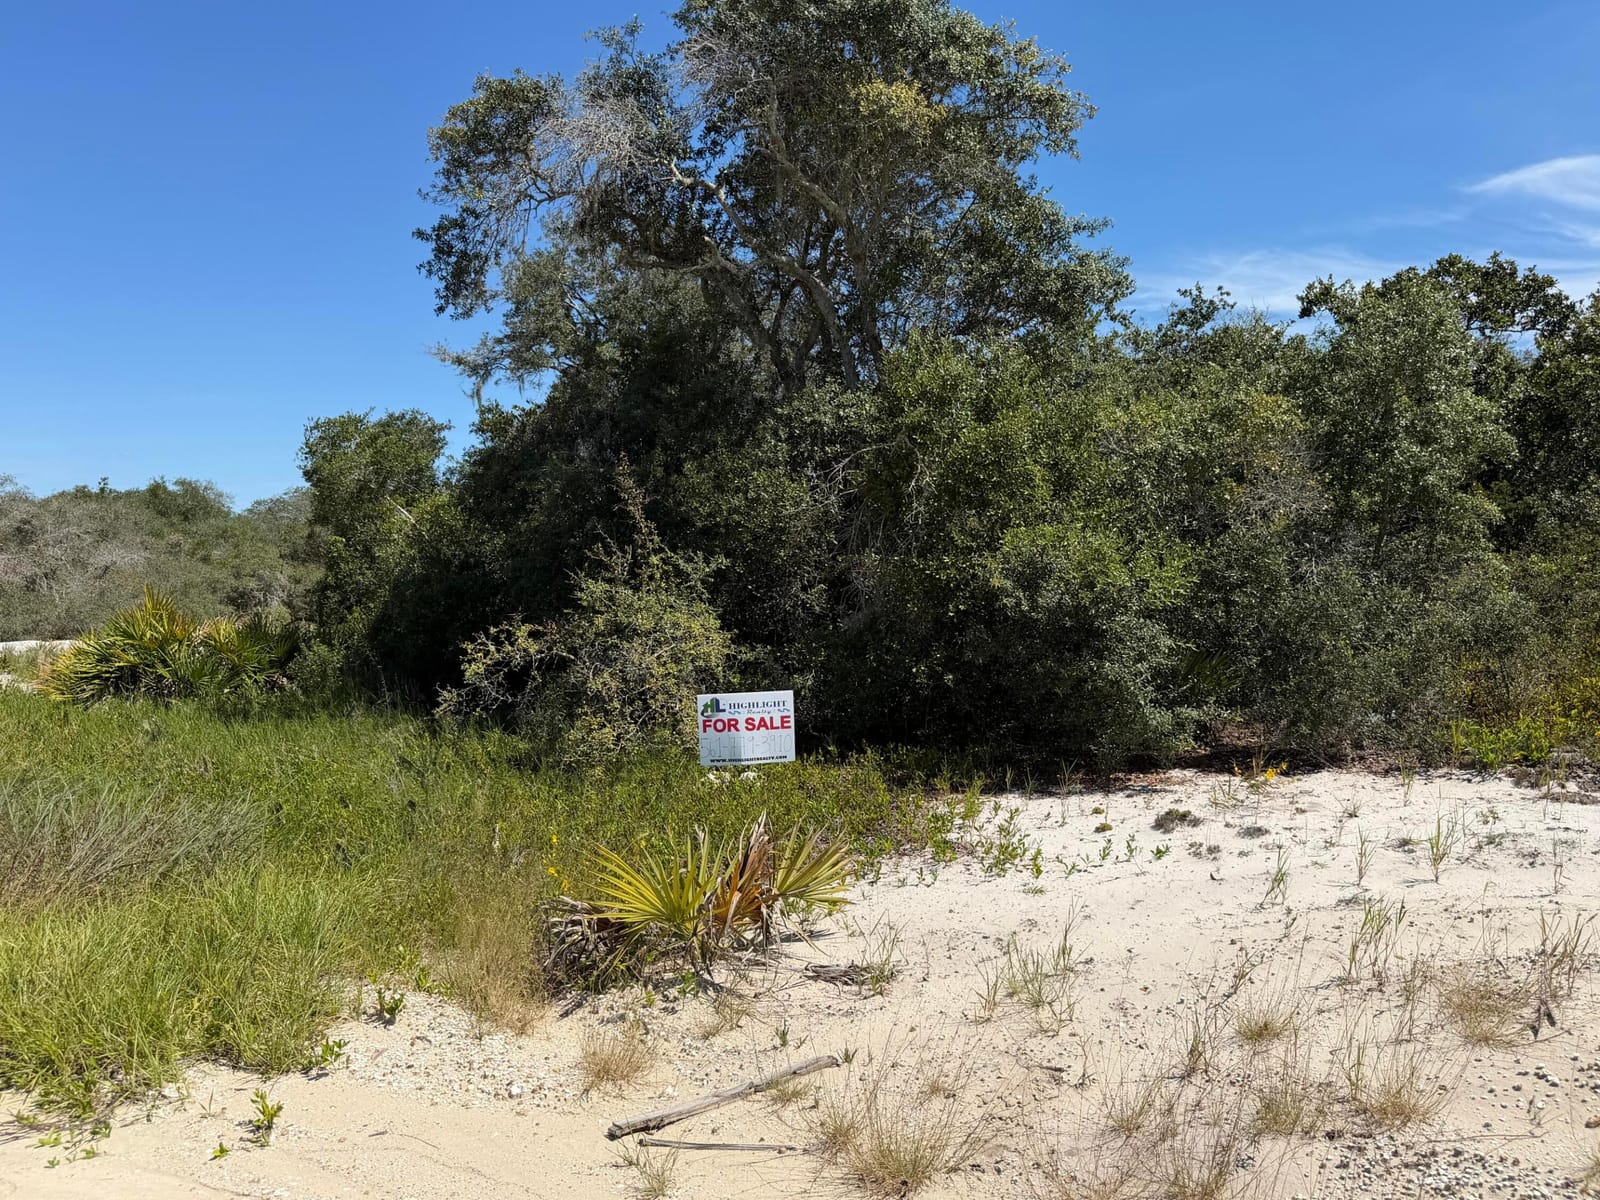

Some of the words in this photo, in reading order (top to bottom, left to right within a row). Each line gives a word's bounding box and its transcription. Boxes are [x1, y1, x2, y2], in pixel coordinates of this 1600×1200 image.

[728, 700, 788, 710] HIGHLIGHT
[746, 708, 772, 716] Realty
[702, 718, 740, 733] FOR
[744, 715, 792, 731] SALE
